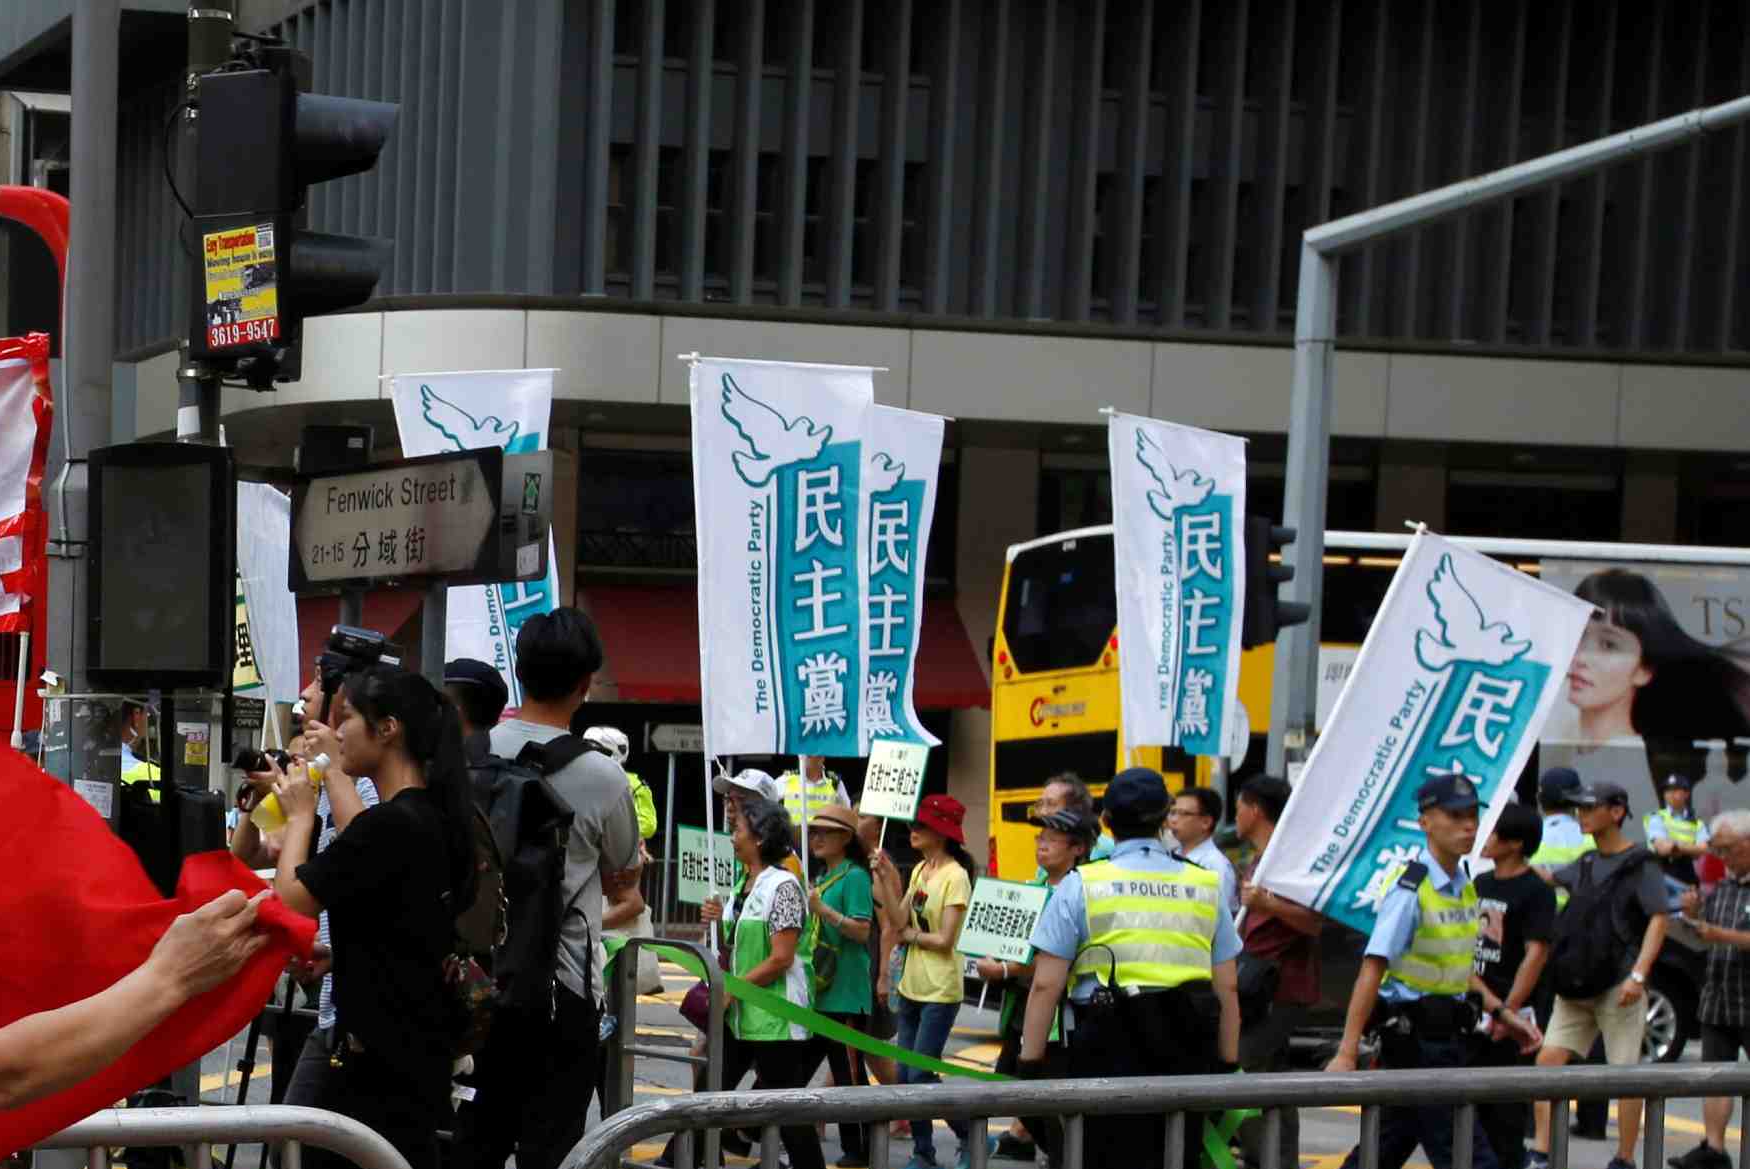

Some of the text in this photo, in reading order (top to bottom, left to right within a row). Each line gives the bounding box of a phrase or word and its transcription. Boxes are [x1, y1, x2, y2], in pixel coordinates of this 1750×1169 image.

[211, 318, 275, 346] 3619-9547
[326, 472, 456, 515] Fenwick Street
[352, 526, 426, 569] 分域街
[1161, 531, 1174, 576] Party
[747, 499, 768, 714] The Democratic Party
[793, 465, 849, 738] 民主黨
[1157, 580, 1174, 676] Democratic
[1178, 511, 1223, 737] 民主黨
[1309, 680, 1427, 875] The Democratic Party
[1129, 881, 1179, 898] POLICE
